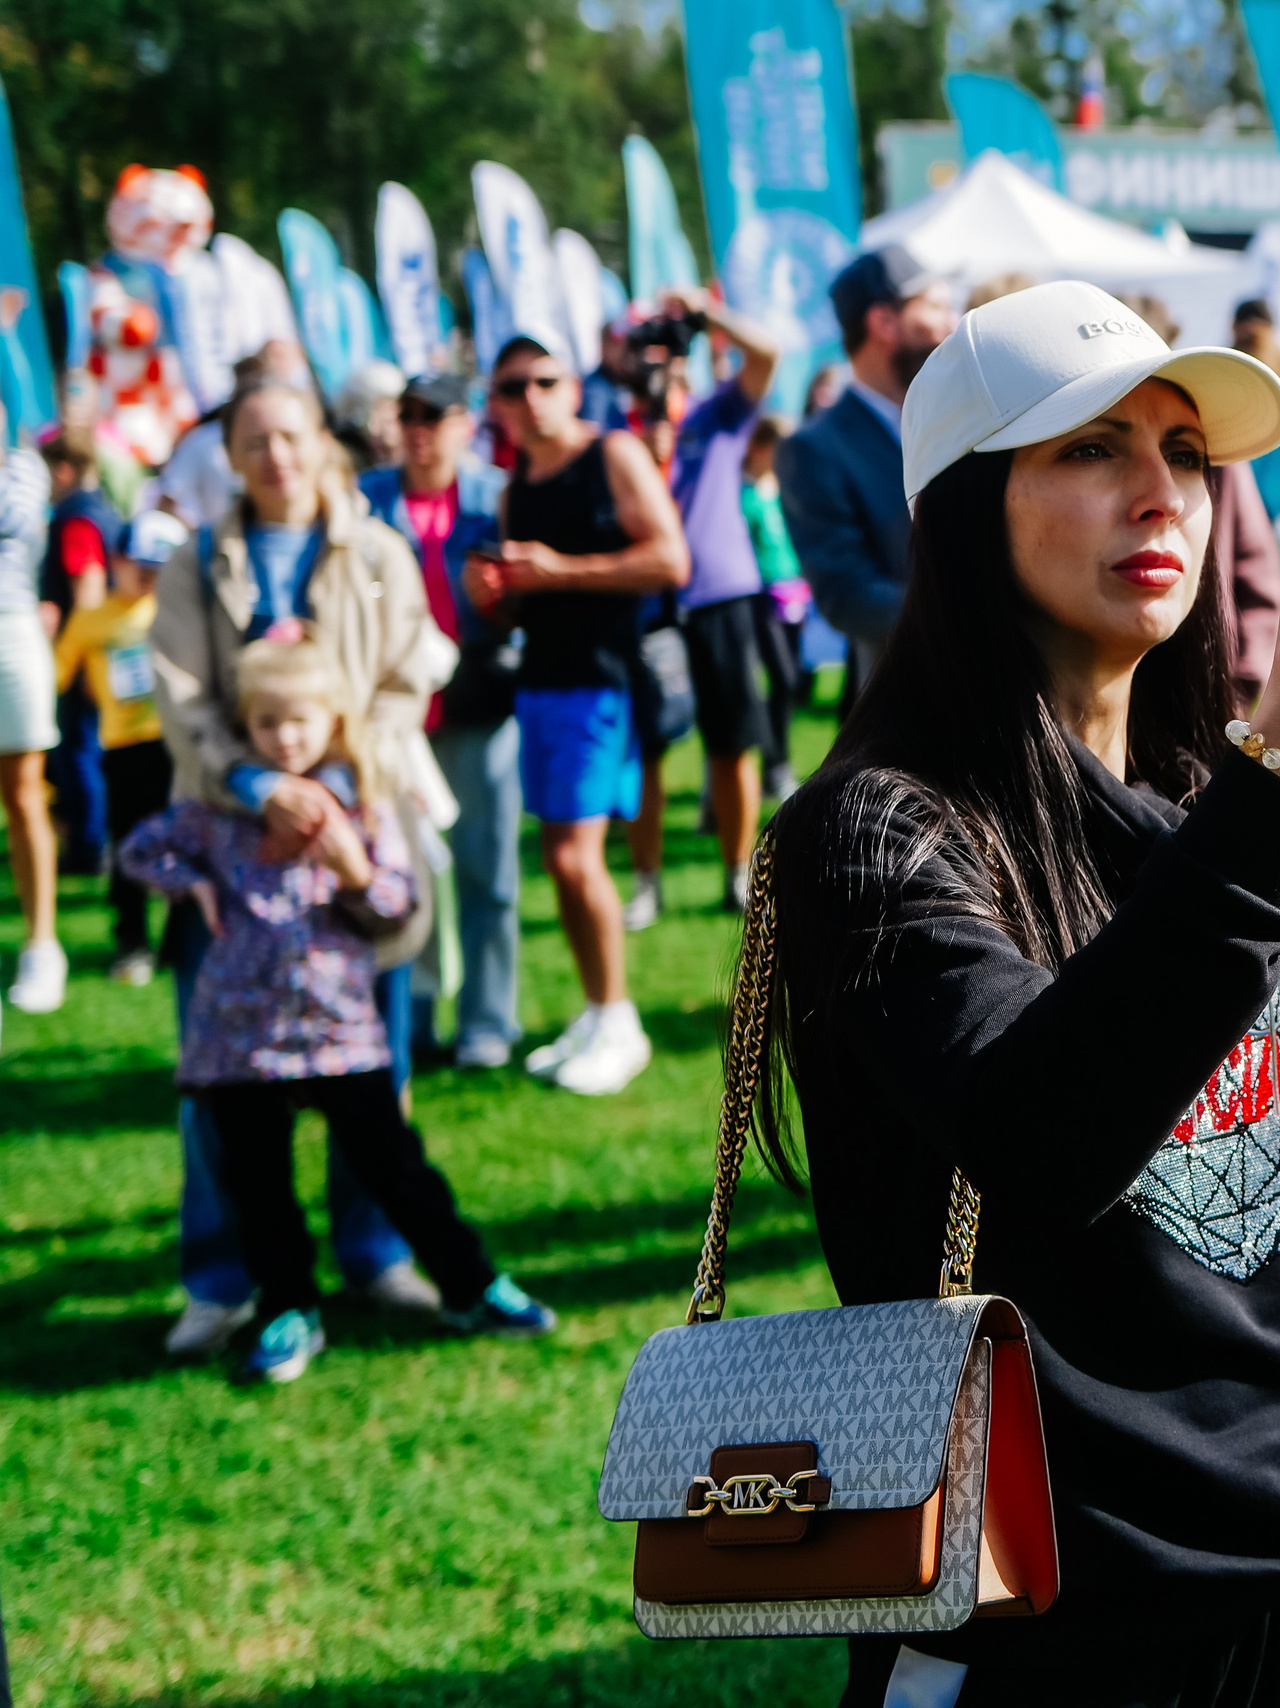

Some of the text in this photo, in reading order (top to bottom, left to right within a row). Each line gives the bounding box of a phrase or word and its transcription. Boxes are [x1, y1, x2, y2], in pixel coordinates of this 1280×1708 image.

[687, 1336, 722, 1358] MK
[720, 1333, 755, 1355] MK
[753, 1330, 789, 1352] MK
[787, 1327, 823, 1349] MK
[821, 1324, 858, 1346] MK
[856, 1322, 894, 1344] MK
[892, 1320, 930, 1342] MK
[660, 1359, 695, 1381] MK
[693, 1356, 728, 1379] MK
[726, 1353, 761, 1376] MK
[759, 1351, 795, 1373] MK
[793, 1348, 830, 1371] MK
[828, 1345, 866, 1368] MK
[864, 1343, 902, 1366] MK
[900, 1341, 938, 1364] MK
[635, 1383, 669, 1406] MK
[667, 1380, 701, 1403] MK
[699, 1377, 735, 1401] MK
[733, 1375, 769, 1398] MK
[767, 1372, 803, 1396] MK
[801, 1370, 838, 1393] MK
[836, 1368, 874, 1391] MK
[872, 1366, 911, 1389] MK
[909, 1364, 948, 1388] MK
[642, 1405, 676, 1428] MK
[674, 1402, 709, 1426] MK
[707, 1400, 743, 1423] MK
[741, 1397, 777, 1421] MK
[775, 1395, 812, 1419] MK
[810, 1393, 847, 1417] MK
[845, 1391, 884, 1415] MK
[882, 1389, 921, 1413] MK
[650, 1427, 684, 1451] MK
[682, 1425, 718, 1449] MK
[820, 1417, 858, 1441] MK
[856, 1415, 895, 1439] MK
[893, 1414, 932, 1438] MK
[626, 1453, 660, 1477] MK
[658, 1451, 693, 1475] MK
[830, 1441, 869, 1466] MK
[867, 1440, 907, 1465] MK
[905, 1439, 945, 1463] MK
[635, 1477, 670, 1501] MK
[842, 1466, 881, 1491] MK
[879, 1465, 919, 1490] MK
[733, 1481, 768, 1508] MK
[654, 1616, 683, 1637] MK
[683, 1615, 715, 1636] MK
[717, 1614, 749, 1636] MK
[751, 1613, 784, 1635] MK
[786, 1612, 818, 1633] MK
[821, 1611, 854, 1632] MK
[856, 1610, 891, 1632] MK
[893, 1609, 928, 1631] MK
